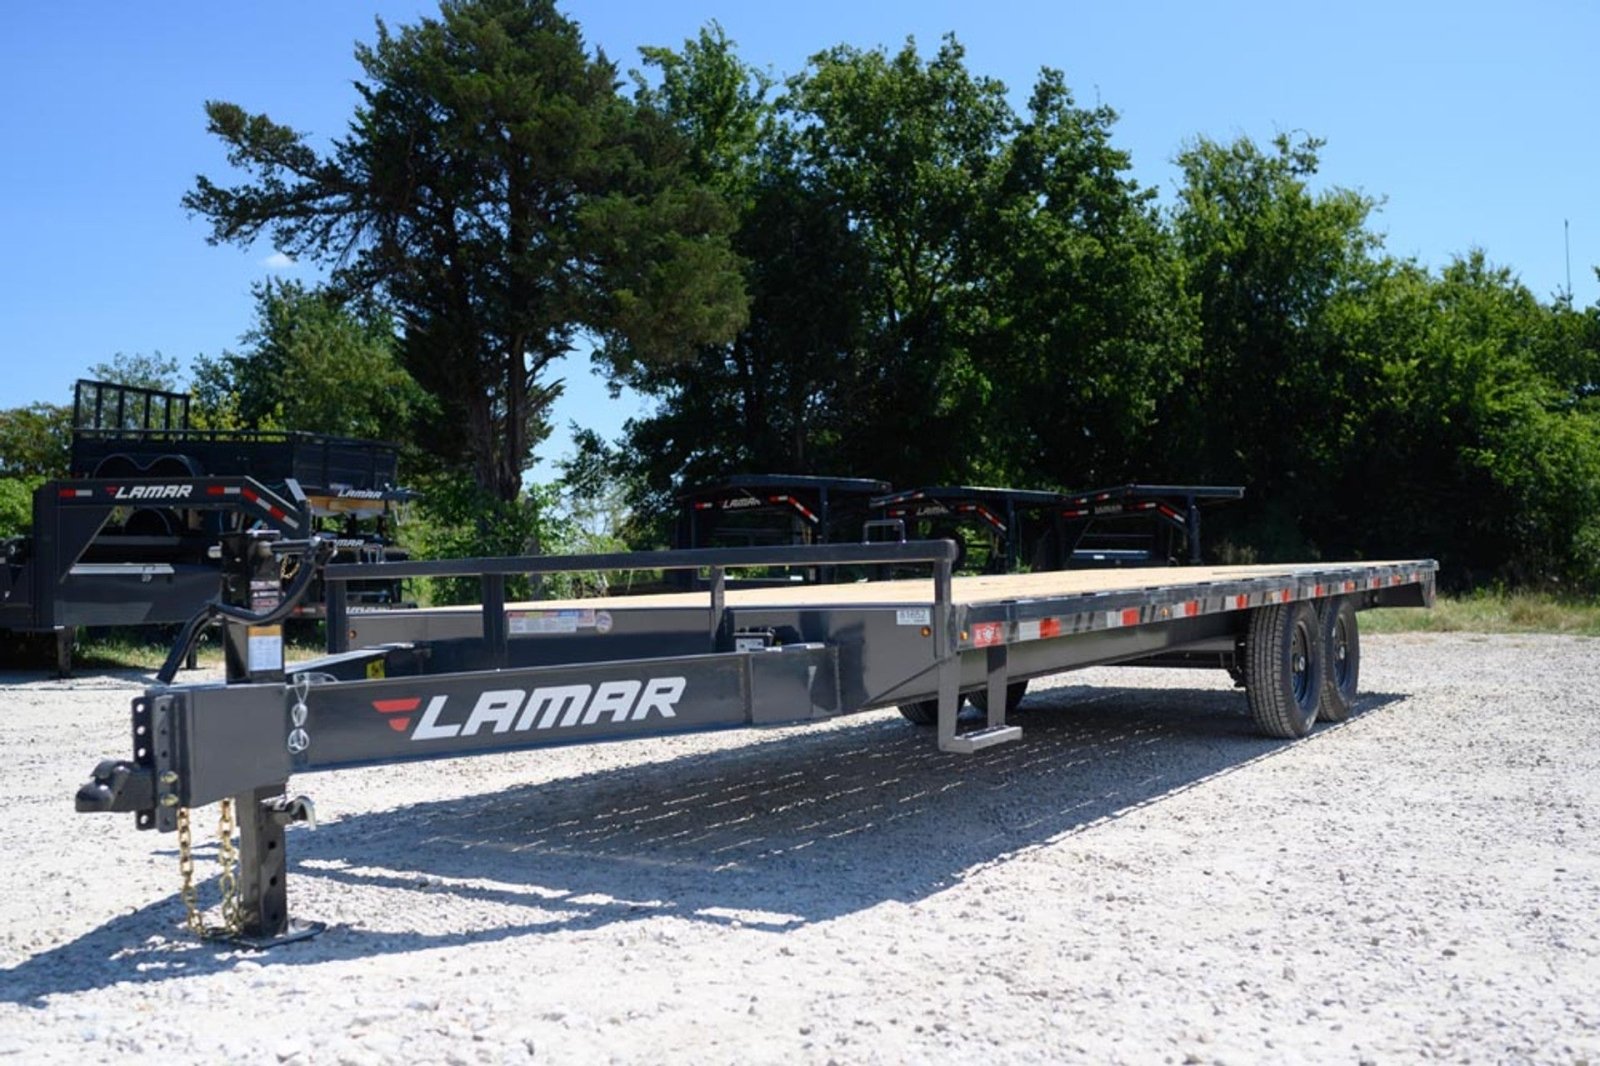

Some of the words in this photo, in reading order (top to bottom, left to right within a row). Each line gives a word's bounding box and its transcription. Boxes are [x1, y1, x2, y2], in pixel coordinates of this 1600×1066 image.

[115, 485, 193, 499] LAMAR
[337, 490, 383, 499] LAMAR
[411, 676, 687, 741] LAMAR
